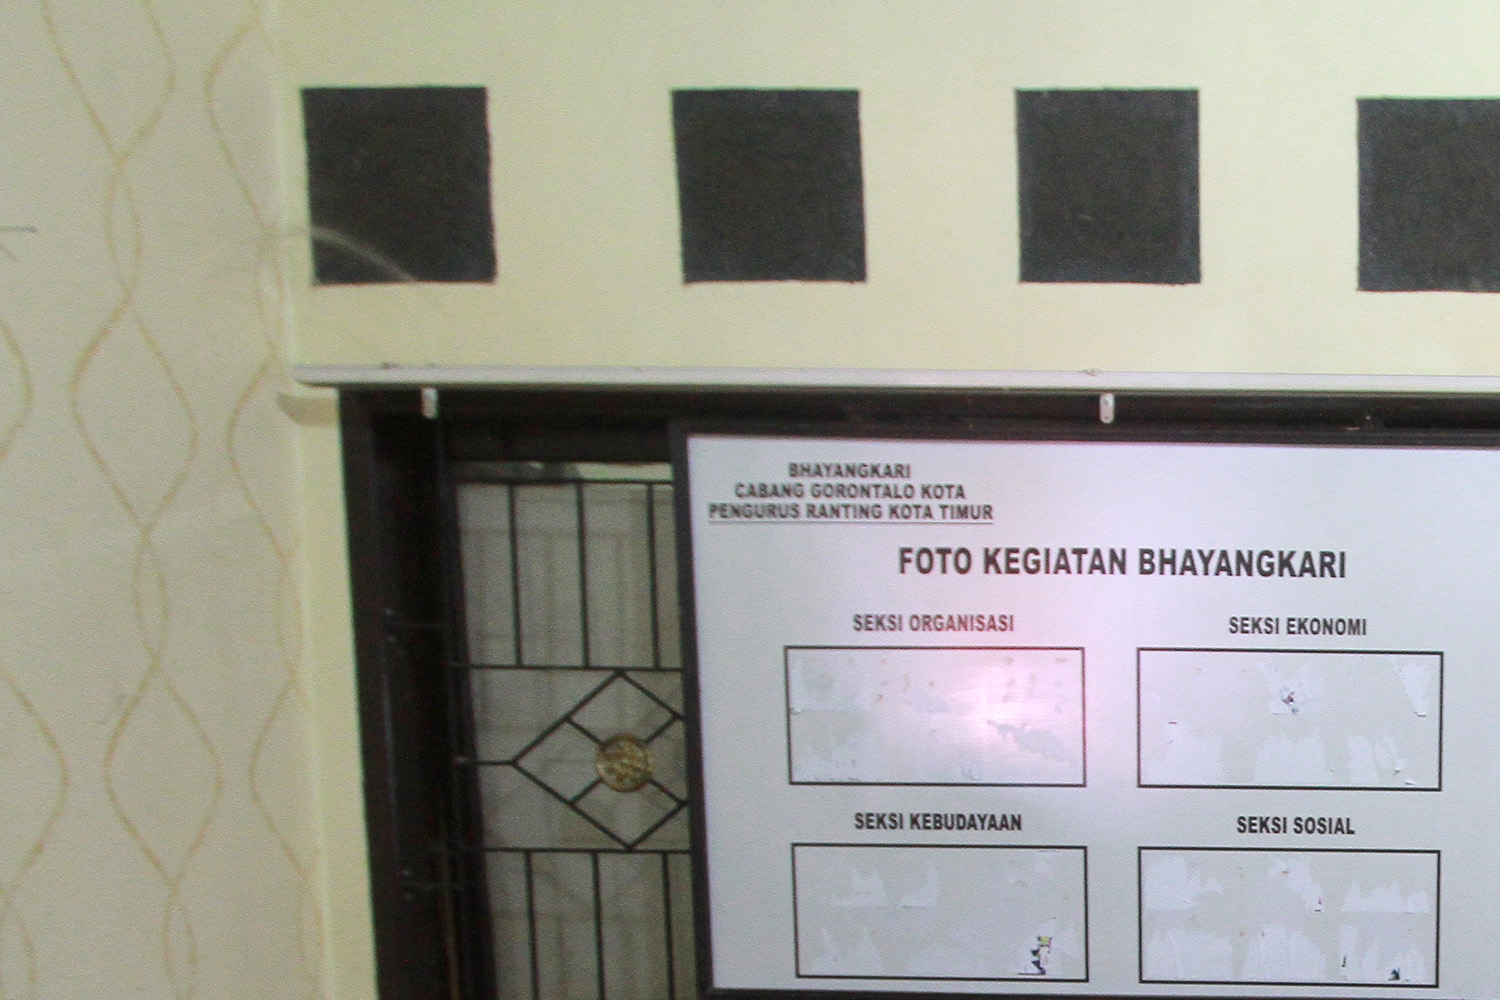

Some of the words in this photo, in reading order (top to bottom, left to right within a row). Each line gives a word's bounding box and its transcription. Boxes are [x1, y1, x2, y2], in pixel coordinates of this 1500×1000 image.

[788, 462, 911, 479] BHAYANGKARI
[734, 482, 805, 499] CABANG
[810, 482, 915, 500] GORONTALO
[920, 484, 966, 500] KOTA
[708, 502, 800, 519] PENGURUS
[806, 503, 883, 520] RANTING
[888, 503, 934, 520] KOTA
[939, 504, 993, 520] TIMUR
[899, 546, 973, 575] FOTO
[983, 546, 1127, 575] KEGIATAN
[1138, 548, 1346, 579] BHAYANGKARI
[853, 613, 903, 632] SEKSI
[908, 613, 1014, 632] ORGANISASI
[1228, 616, 1280, 635] SEKSI
[1286, 617, 1367, 636] EKONOMI
[854, 812, 904, 830] SEKSI
[909, 812, 1022, 831] KEBUDAYAAN
[1236, 815, 1287, 834] SEKSI
[1293, 816, 1356, 835] SOSIAL
